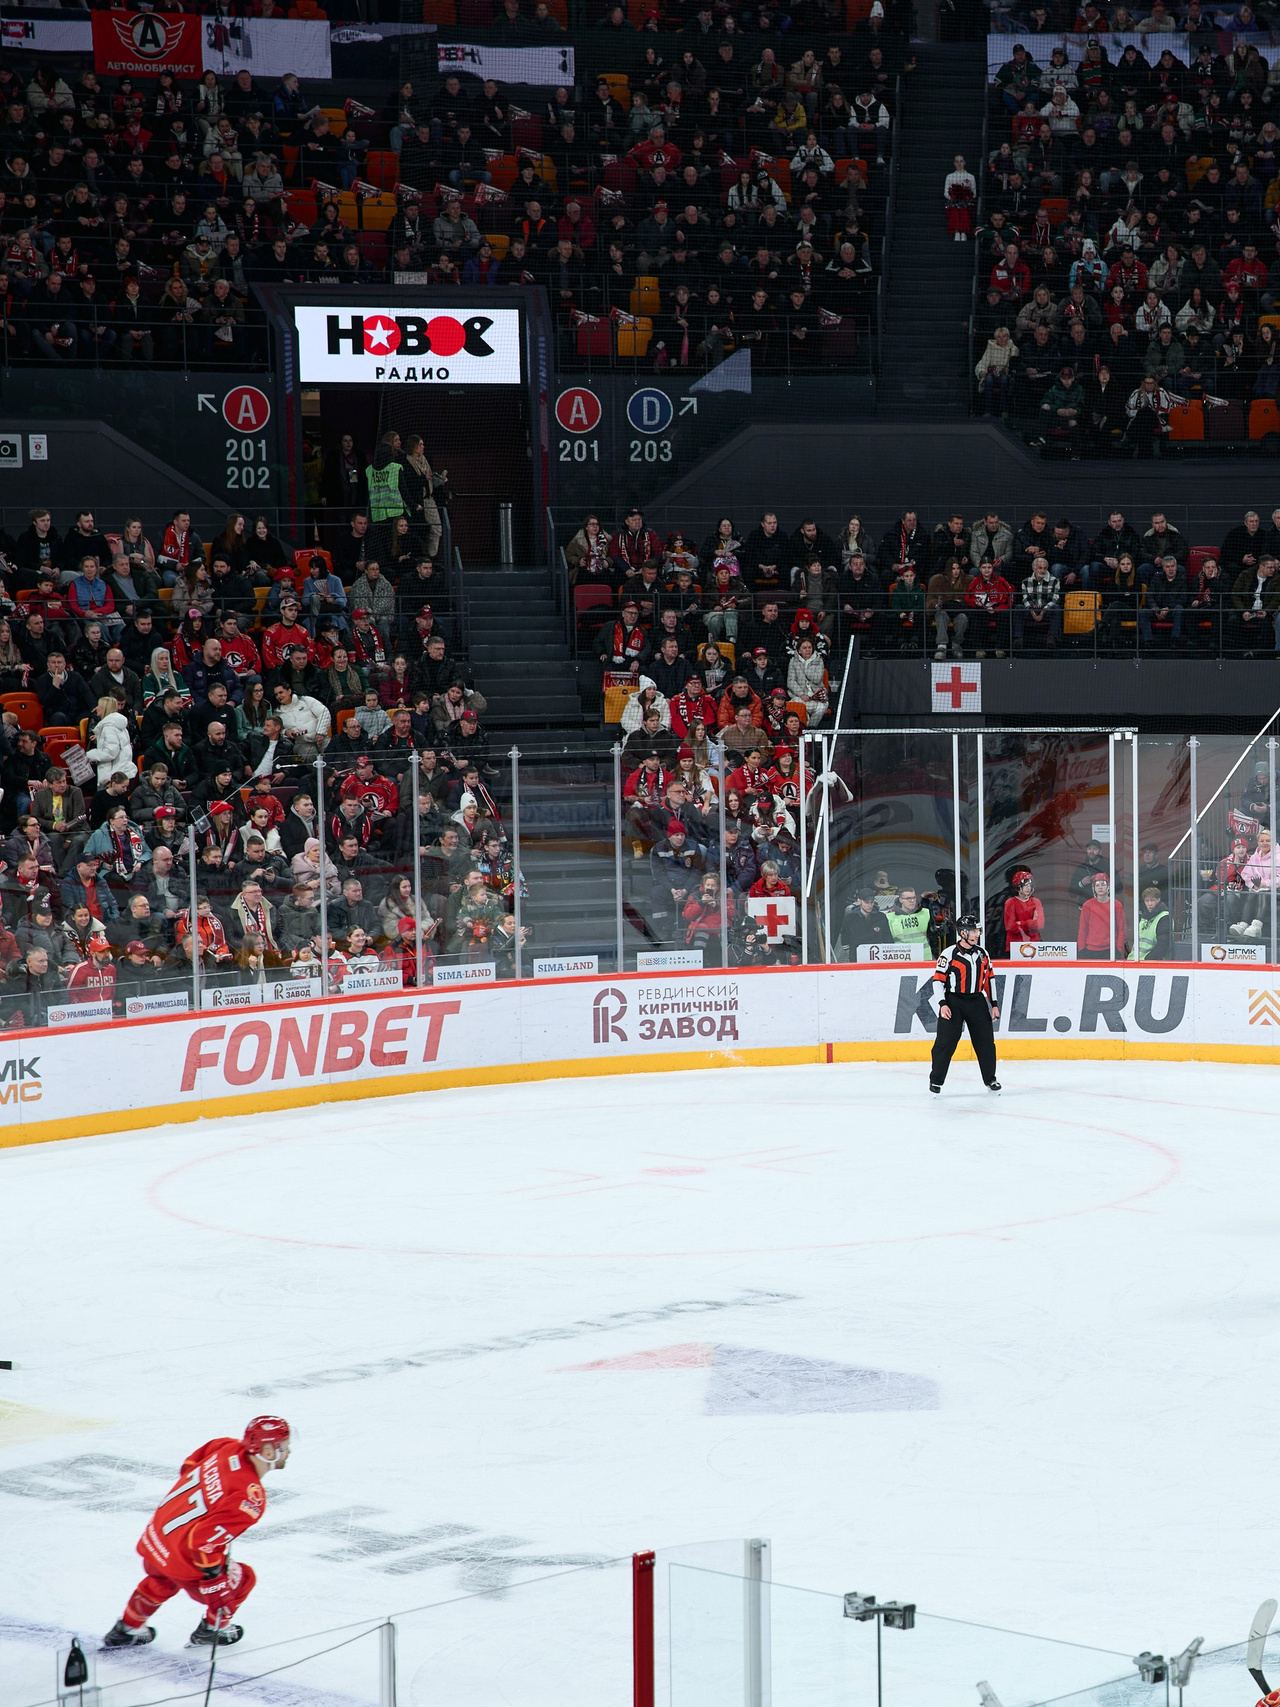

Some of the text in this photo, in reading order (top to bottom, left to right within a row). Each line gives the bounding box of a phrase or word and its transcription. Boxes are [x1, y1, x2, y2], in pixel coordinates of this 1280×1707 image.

[106, 61, 195, 74] АВТОМОБИЛИСТ
[376, 367, 450, 381] РАДИО
[237, 394, 258, 425] A
[570, 395, 589, 426] A
[643, 396, 661, 426] D
[225, 438, 267, 462] 201
[559, 440, 599, 462] 201
[629, 440, 673, 462] 203
[226, 466, 271, 489] 202
[883, 953, 911, 961] ЗАВОД
[225, 997, 250, 1006] ЗАВОД
[286, 990, 311, 998] ЗАВОД
[638, 983, 739, 1000] РЕВДИНСКИЙ
[67, 1007, 111, 1019] УРАЛМАШЗАВОД
[144, 998, 188, 1011] УРАЛМАШЗАВОД
[639, 998, 738, 1015] КИРПИЧНЫЙ
[894, 974, 1189, 1034] KL.RU
[639, 1015, 738, 1041] ЗАВОД
[180, 1000, 461, 1093] FONBET
